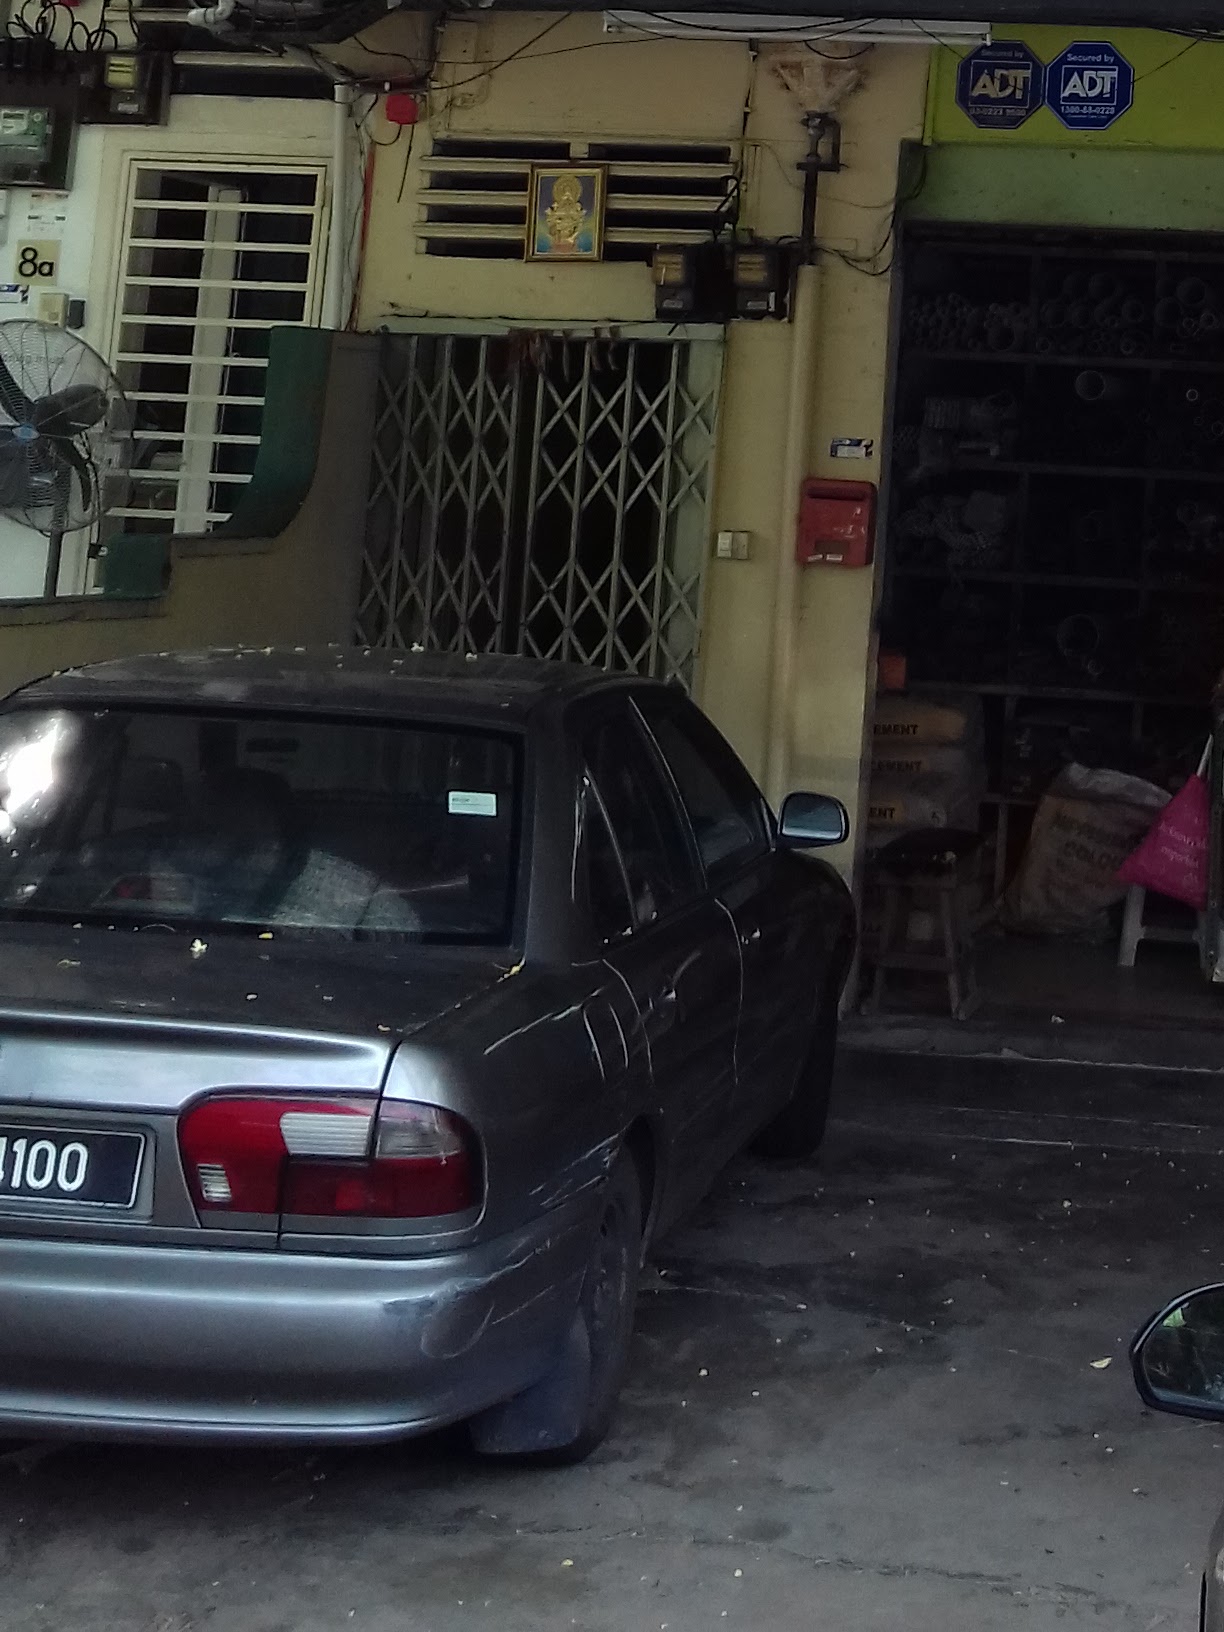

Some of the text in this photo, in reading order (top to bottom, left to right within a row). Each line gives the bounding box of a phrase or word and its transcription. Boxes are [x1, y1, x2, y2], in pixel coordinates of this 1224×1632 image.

[1066, 53, 1115, 63] Secured by
[970, 68, 1032, 100] ADT
[1060, 70, 1117, 99] ADT
[18, 246, 55, 278] 8a
[873, 723, 919, 735] EMENT
